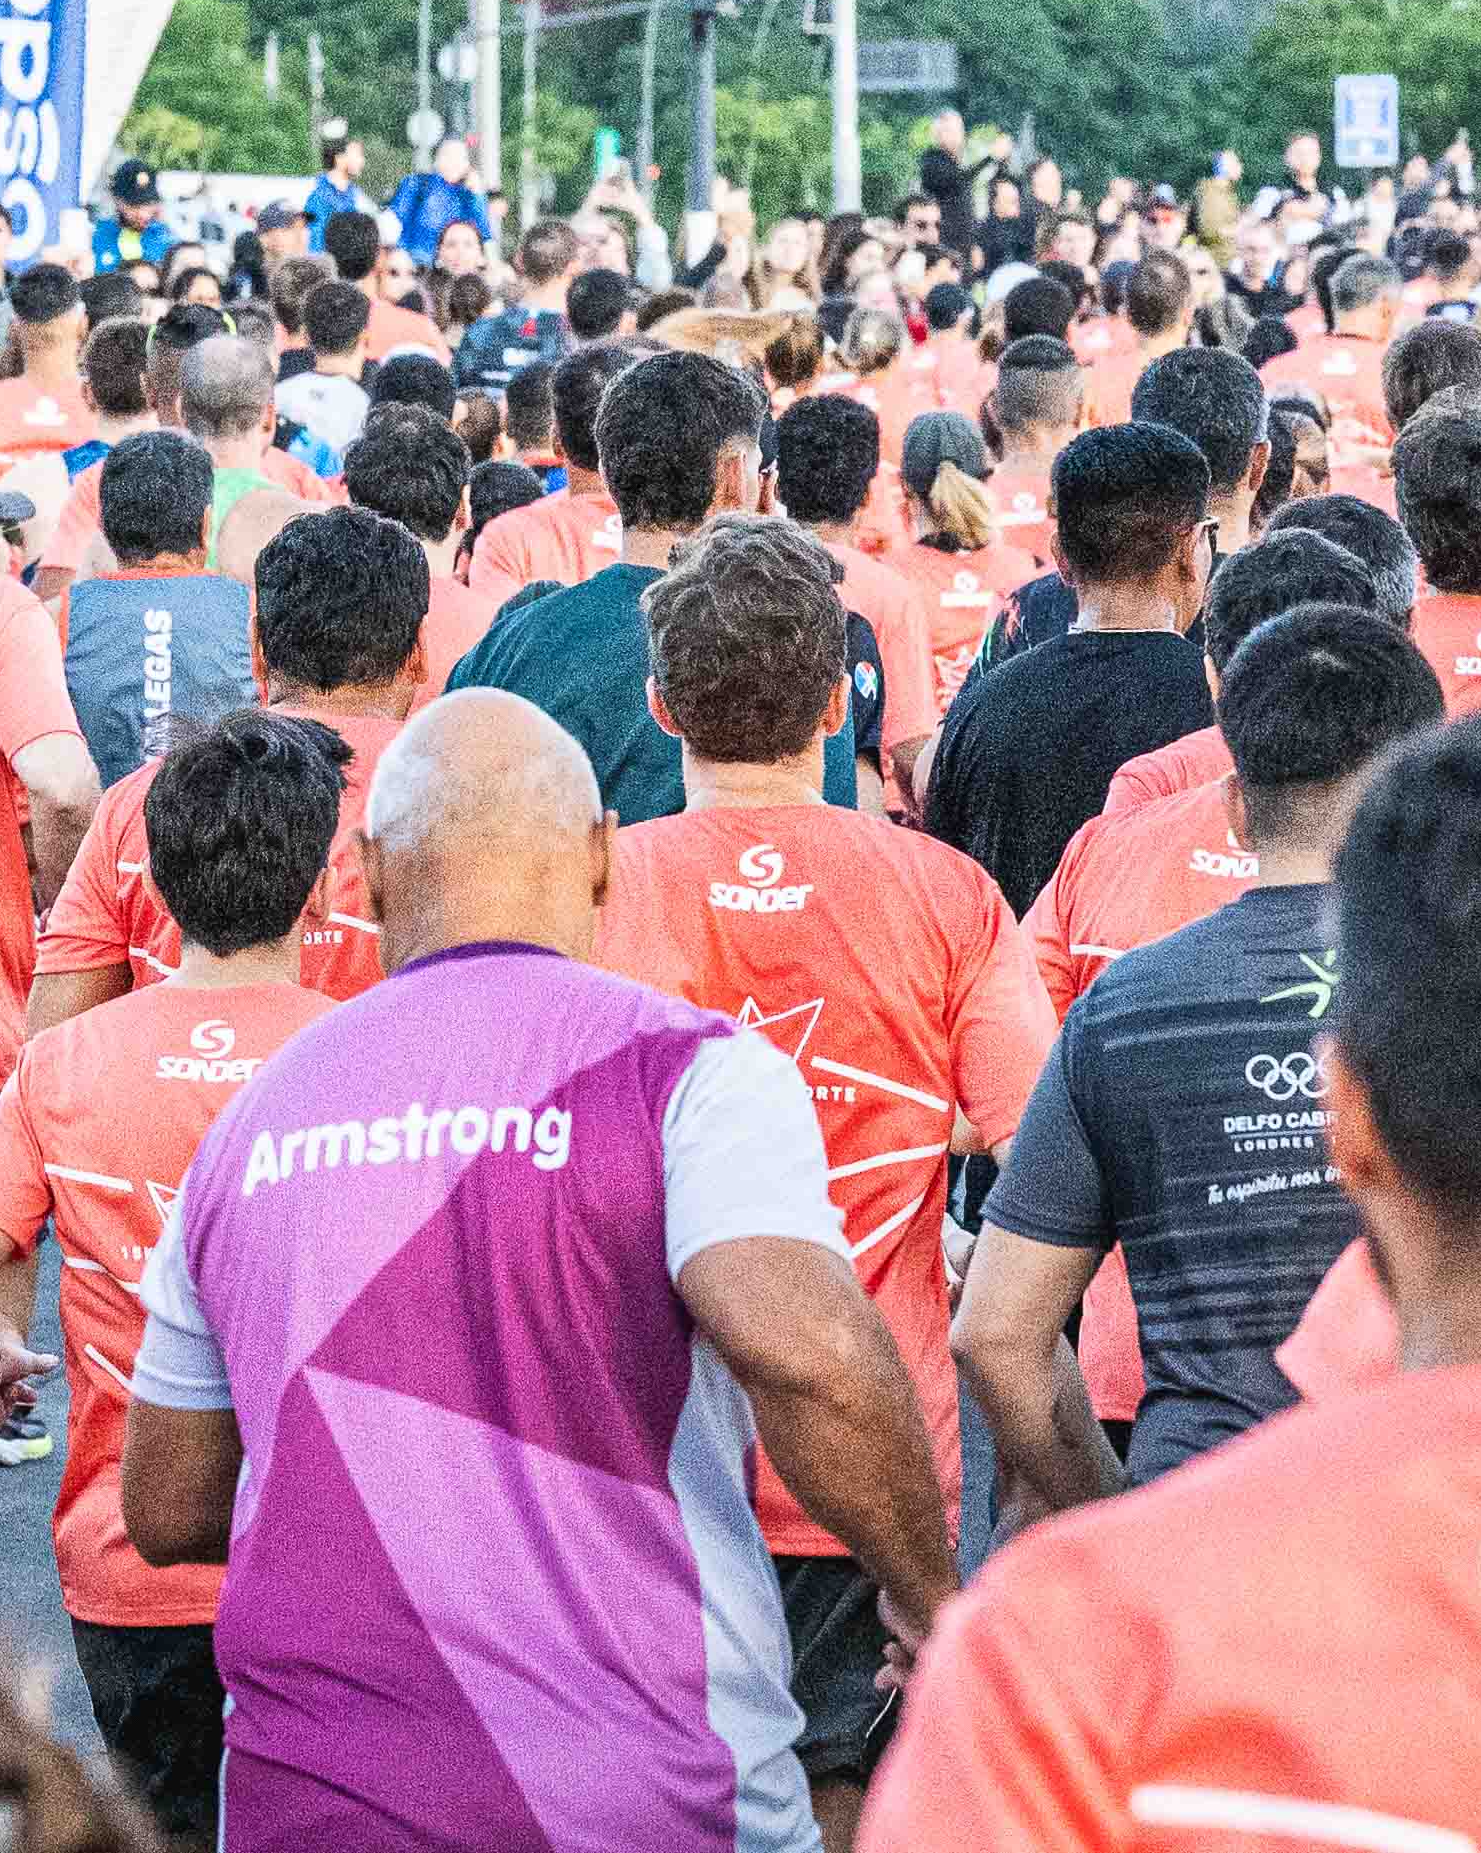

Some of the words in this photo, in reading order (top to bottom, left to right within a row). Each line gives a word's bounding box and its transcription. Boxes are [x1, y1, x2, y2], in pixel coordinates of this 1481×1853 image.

[302, 930, 343, 945] ORTE
[1223, 1113, 1283, 1133] DELFO
[242, 1099, 573, 1196] Armstrong
[1234, 1136, 1315, 1152] LONDRES
